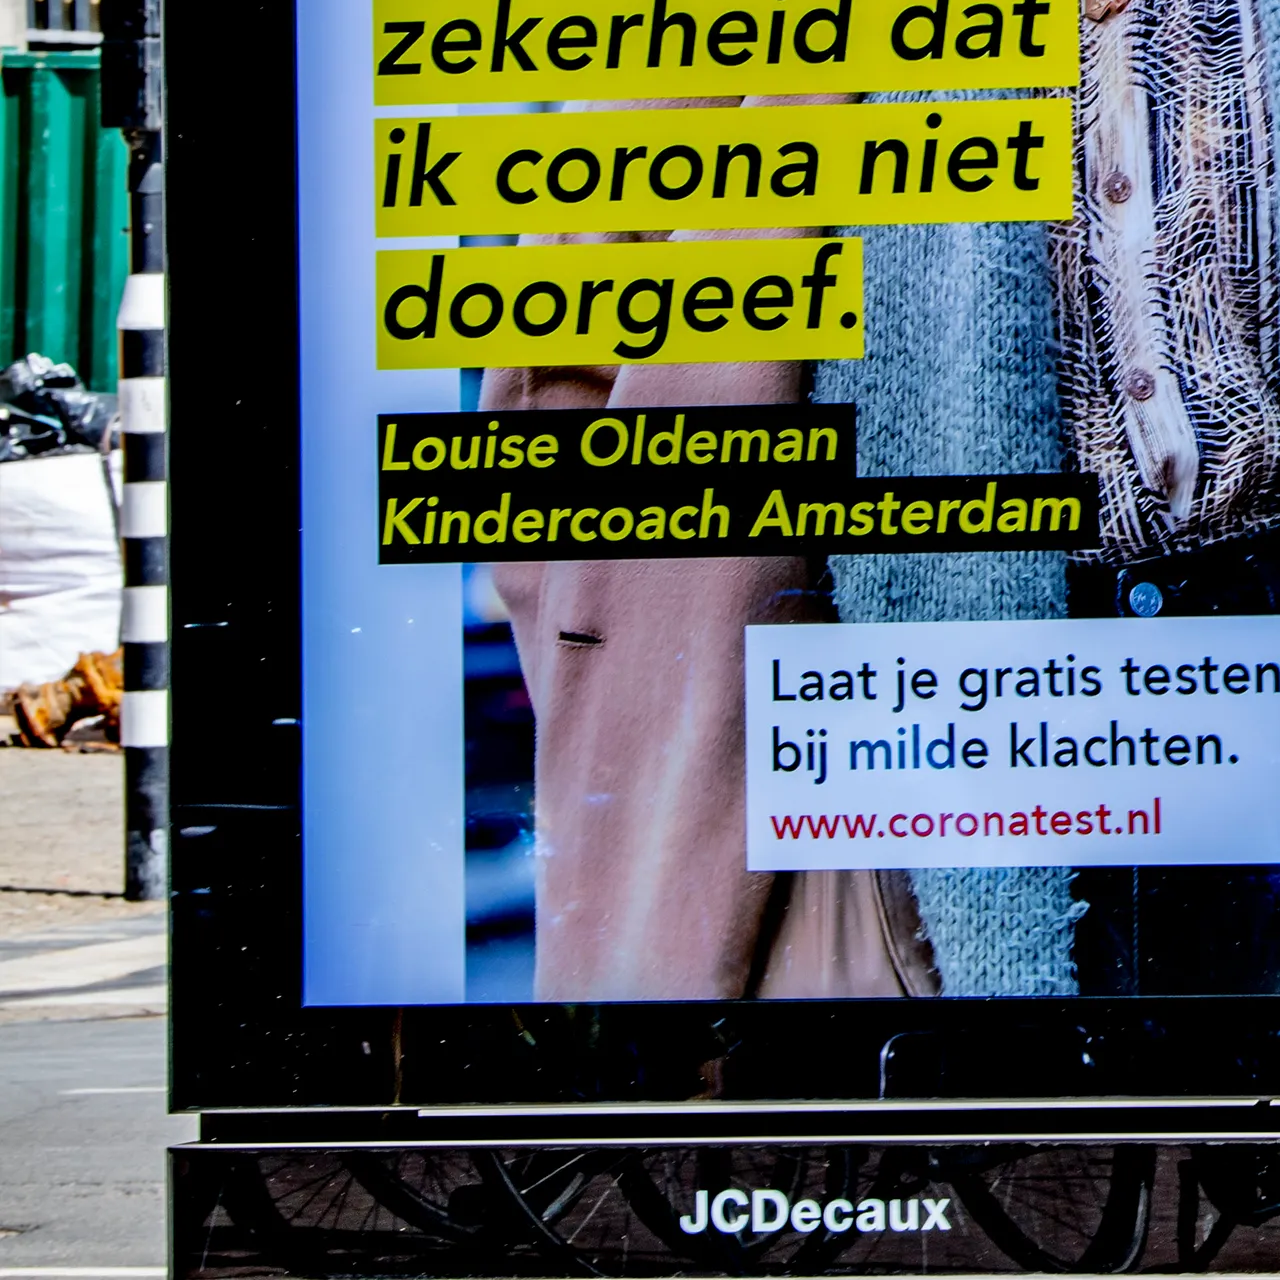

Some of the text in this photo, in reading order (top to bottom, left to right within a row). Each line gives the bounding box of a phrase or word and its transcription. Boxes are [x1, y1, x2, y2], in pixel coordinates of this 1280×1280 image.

[383, 113, 1044, 207] ik corona niet
[384, 243, 857, 361] doorgeef.
[382, 415, 837, 470] Louise Oldeman
[383, 482, 1080, 545] Kindercoach Amsterdam
[773, 654, 1280, 713] Laat je gratis testen
[773, 720, 1238, 784] bij milde klachten.
[771, 797, 1161, 839] www.coronatest.nl
[680, 1189, 951, 1233] JCDecaux
